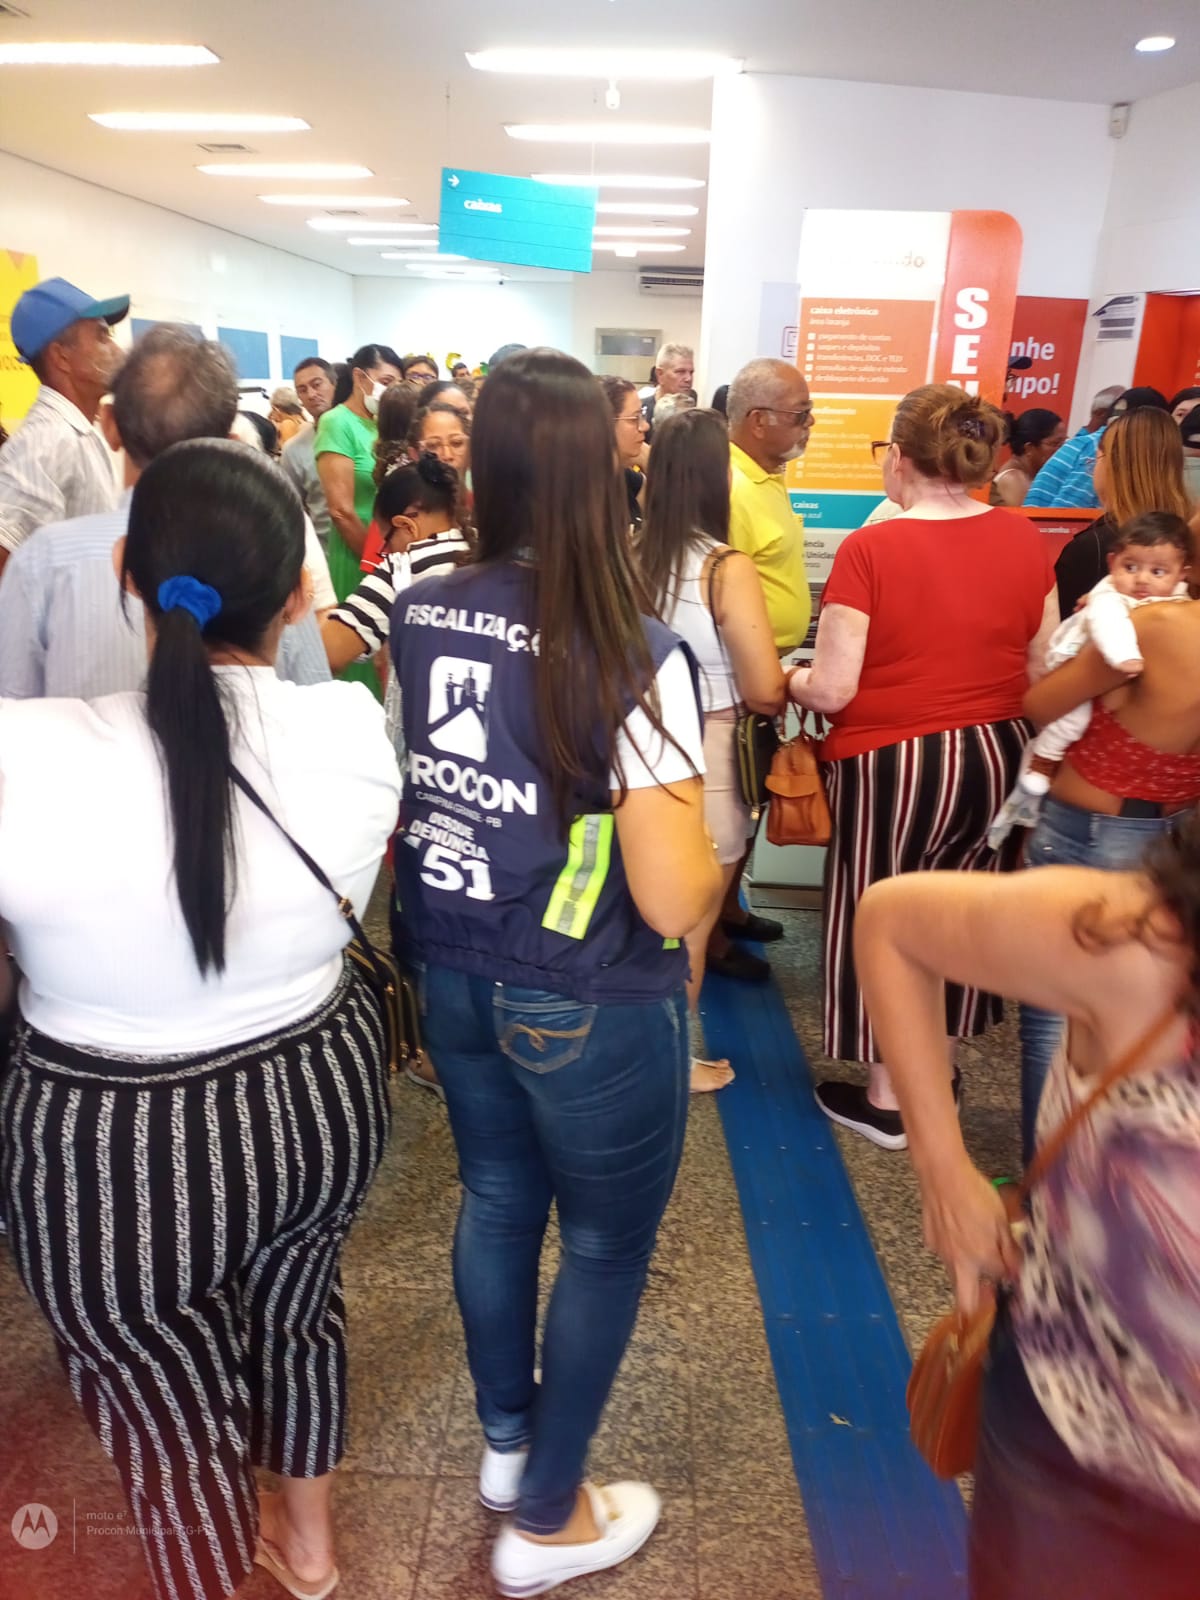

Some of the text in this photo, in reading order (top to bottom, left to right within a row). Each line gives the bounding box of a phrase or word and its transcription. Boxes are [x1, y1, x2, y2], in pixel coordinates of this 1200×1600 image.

[809, 306, 833, 315] caixa
[792, 501, 819, 509] caixas
[404, 604, 541, 657] FISCALIZAÇ
[406, 750, 538, 815] ROCON
